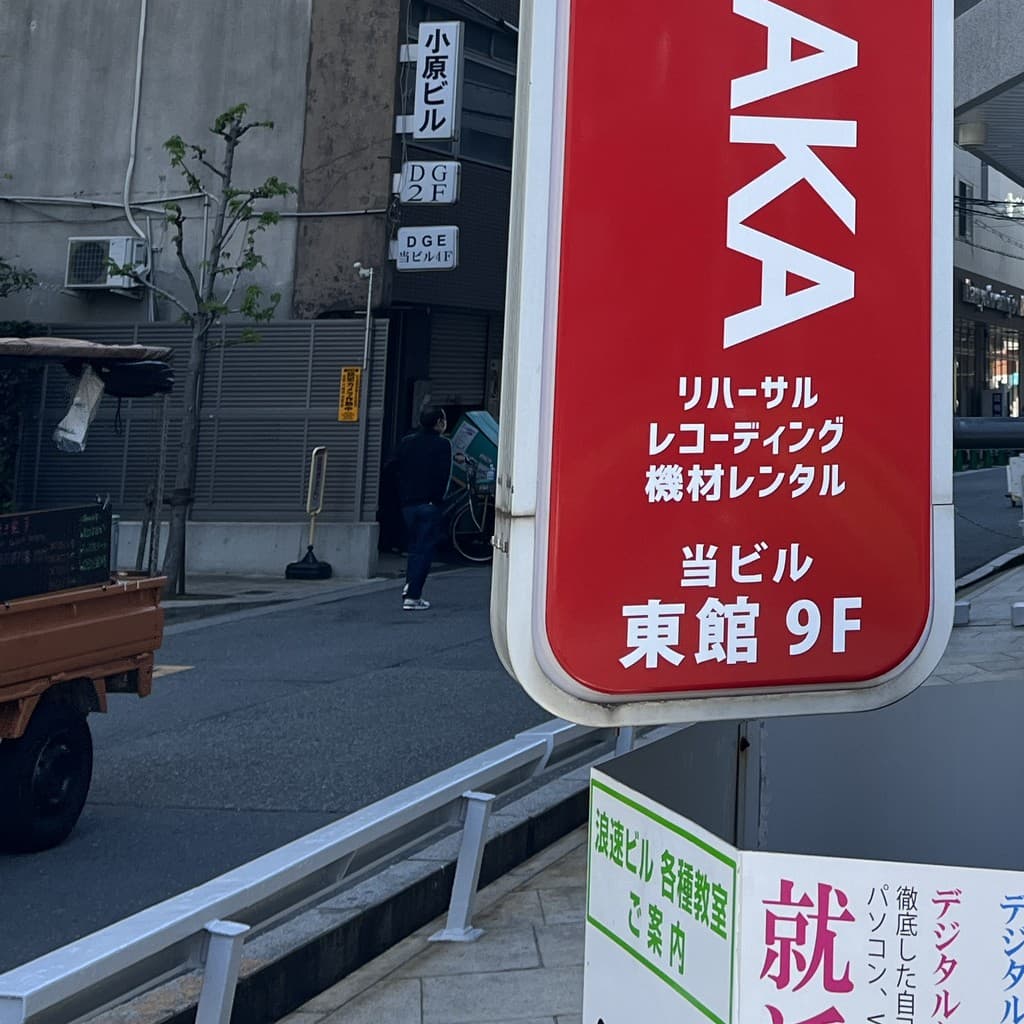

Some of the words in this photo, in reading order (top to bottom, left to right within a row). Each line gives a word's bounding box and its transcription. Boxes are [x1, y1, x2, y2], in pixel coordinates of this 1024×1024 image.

[418, 28, 451, 134] 小原ビル
[407, 235, 446, 247] DGE
[678, 376, 818, 410] リハーサル
[649, 416, 845, 456] レコーディング
[645, 463, 846, 503] 機材レンタル
[680, 541, 814, 588] 当ビル
[619, 595, 760, 669] 東館
[785, 596, 863, 656] 9F
[594, 807, 654, 884] 浪速ビル
[660, 849, 728, 941] 各種教室
[627, 891, 687, 975] ご案内
[760, 878, 856, 1024] 就
[931, 888, 963, 1024] デジタル
